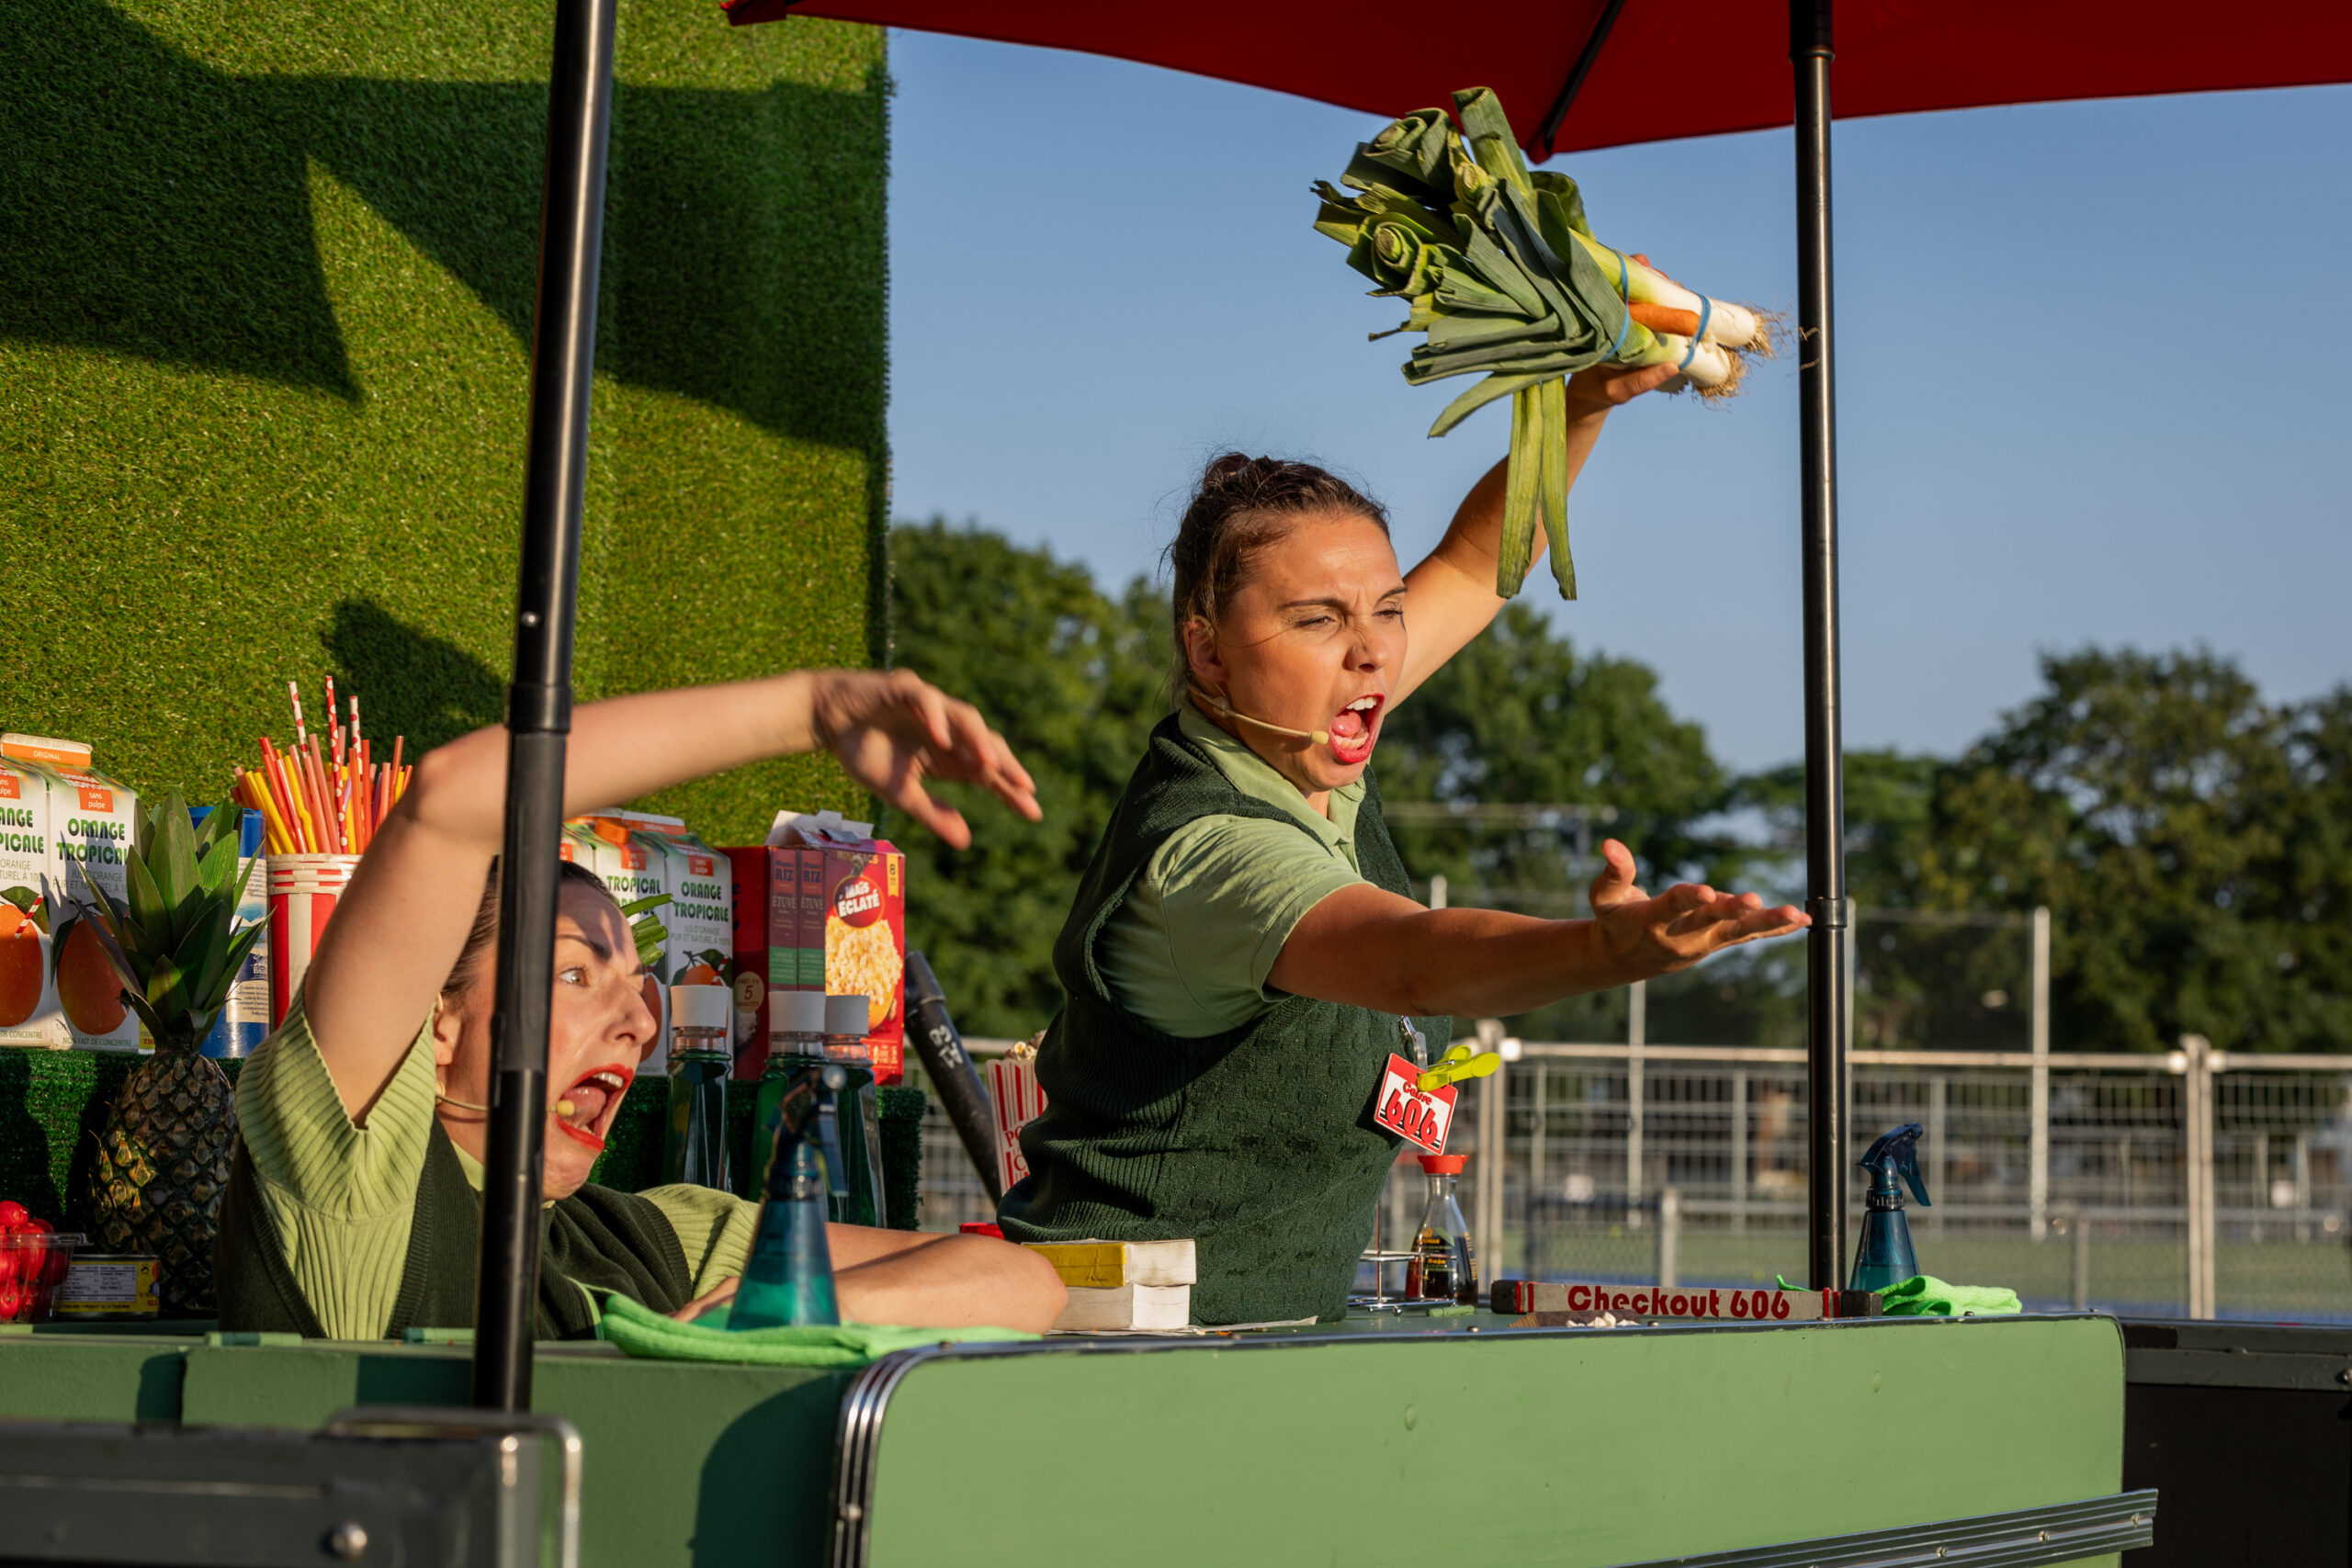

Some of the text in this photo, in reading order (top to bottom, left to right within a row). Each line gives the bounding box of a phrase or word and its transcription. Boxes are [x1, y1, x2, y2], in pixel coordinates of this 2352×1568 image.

[33, 750, 61, 761] ORIGINAL
[88, 800, 106, 809] pulpe
[67, 818, 125, 840] ORANGE
[56, 841, 129, 866] TROPICAL
[775, 868, 794, 882] RIZ
[803, 869, 821, 883] RIZ
[889, 863, 896, 875] 8
[607, 875, 661, 895] TROPICAL
[681, 881, 722, 901] ORANGE
[844, 881, 870, 900] MAÏS
[772, 893, 797, 909] ÉTUVÉ
[801, 895, 824, 910] ÉTUVÉ
[837, 887, 880, 918] ÉCLATÉ
[673, 901, 729, 922] TROPICALE
[743, 985, 753, 1000] 5
[9, 1030, 43, 1039] CONCENTRÉ
[100, 1038, 132, 1046] CONCENTRÉ
[1385, 1088, 1439, 1145] 606
[1567, 1285, 1790, 1320] Checkout 606
